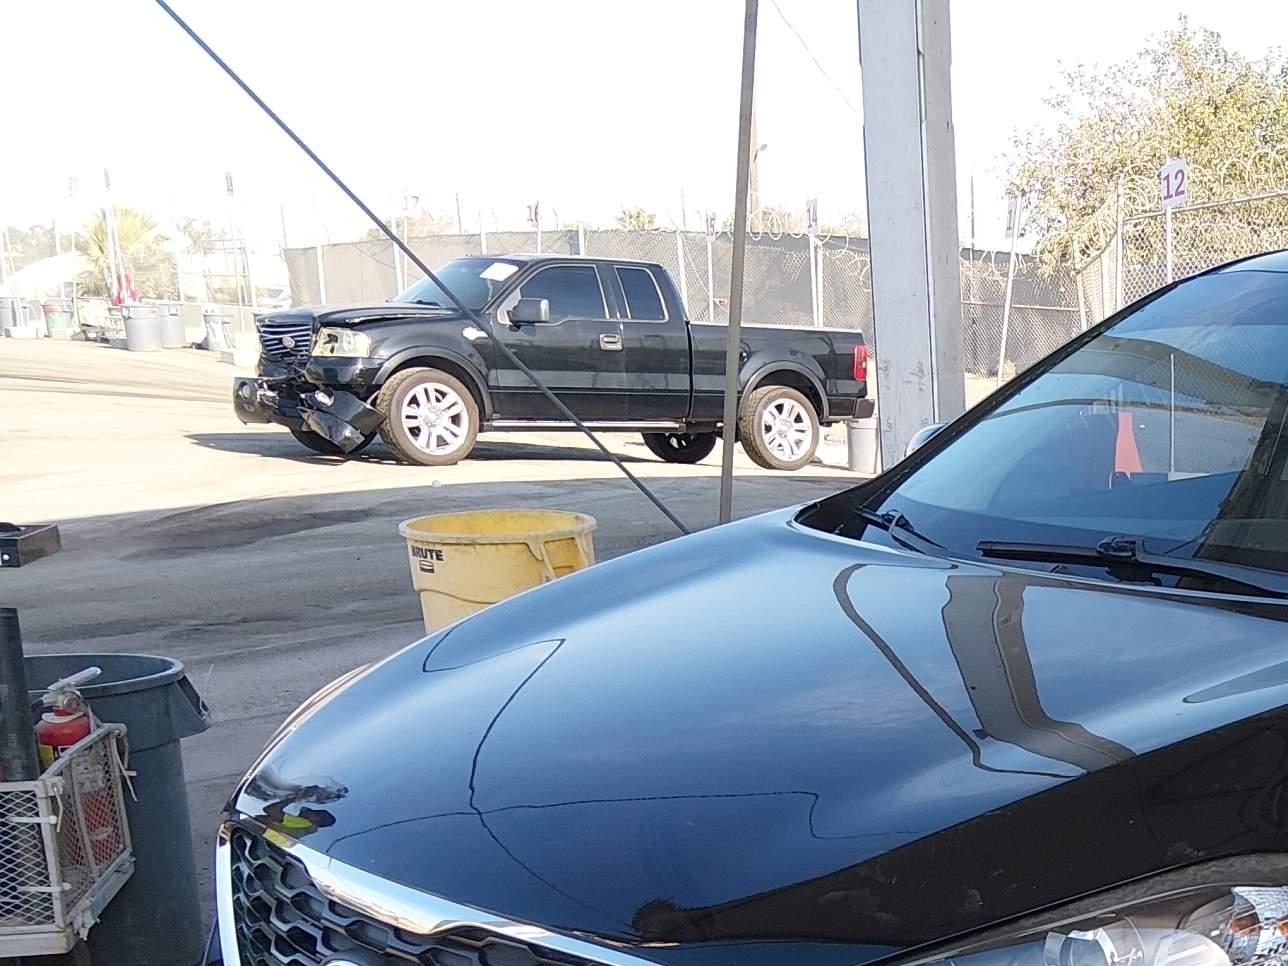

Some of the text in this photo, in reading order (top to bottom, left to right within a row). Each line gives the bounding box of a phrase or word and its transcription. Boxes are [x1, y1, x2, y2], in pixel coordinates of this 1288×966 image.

[1162, 168, 1185, 200] 12
[806, 204, 818, 229] 14
[411, 545, 444, 561] BRUTE
